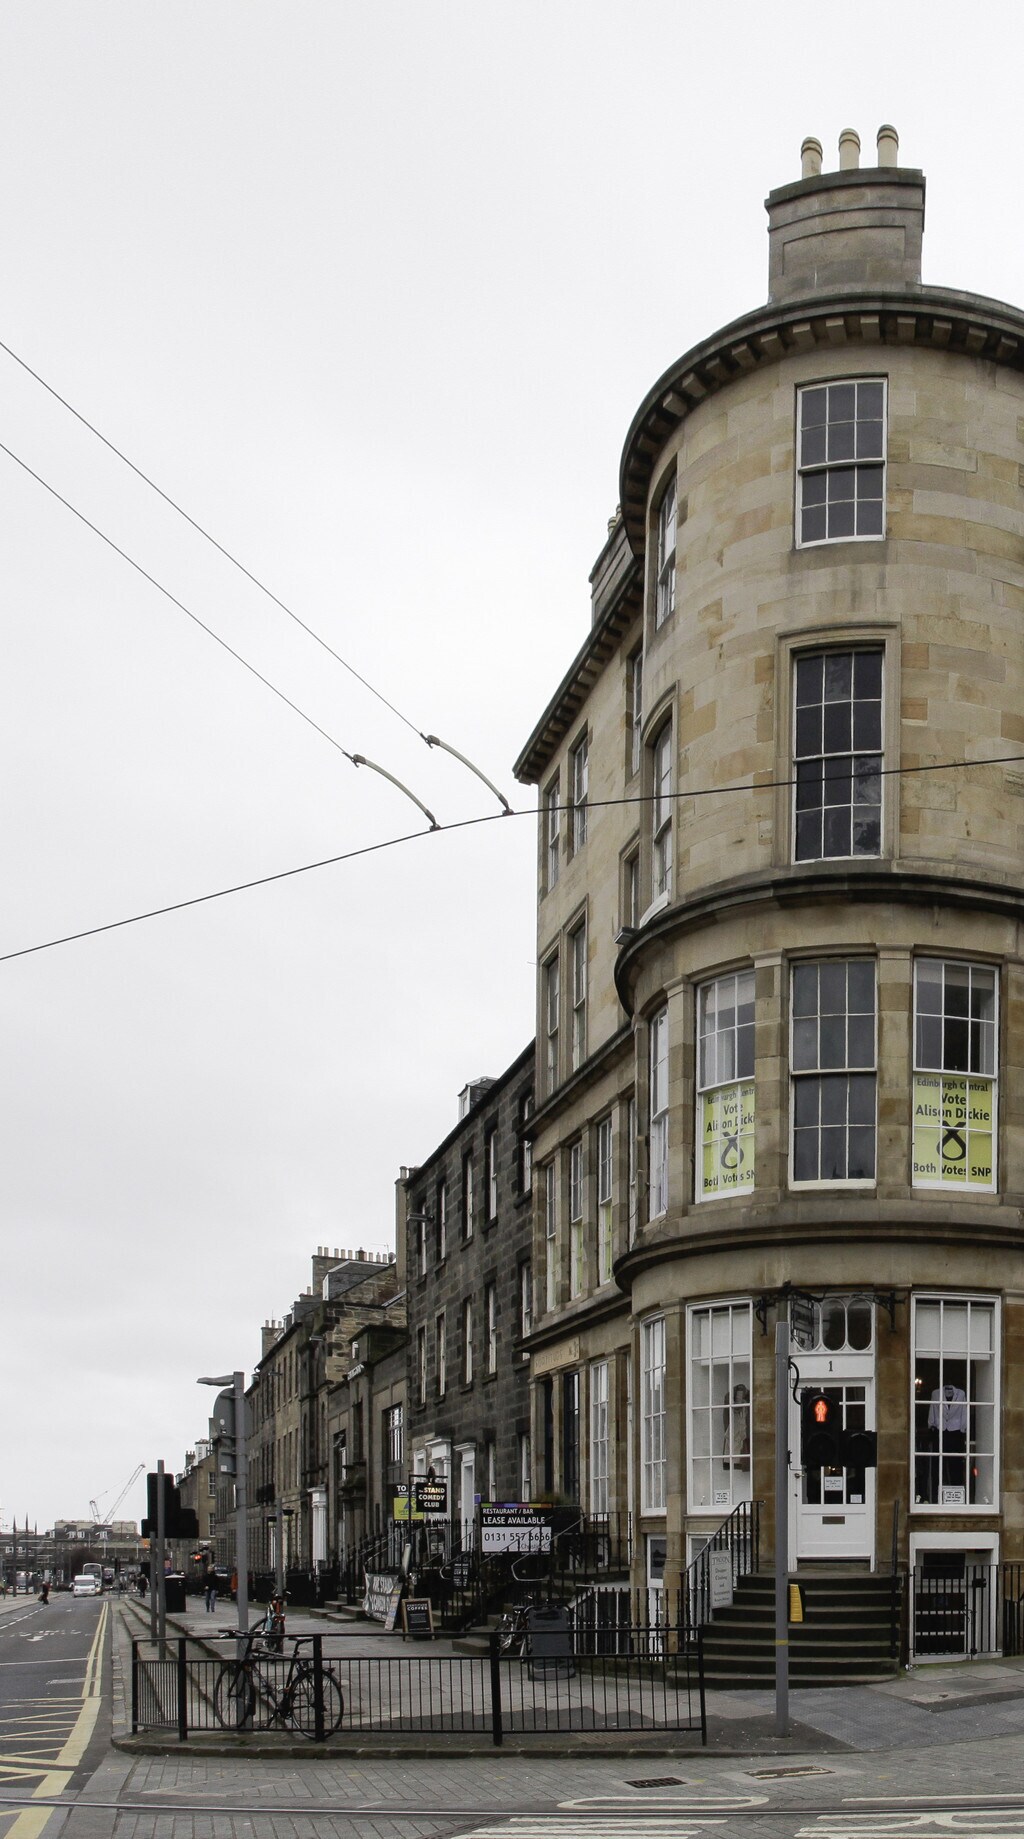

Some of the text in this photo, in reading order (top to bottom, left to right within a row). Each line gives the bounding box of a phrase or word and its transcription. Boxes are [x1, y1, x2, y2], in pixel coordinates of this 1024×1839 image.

[960, 1082, 988, 1092] Cntral
[956, 1108, 990, 1120] Dickie
[706, 1119, 732, 1132] Alion
[914, 1162, 936, 1173] Both
[972, 1167, 992, 1177] SNP
[484, 1533, 506, 1541] 0131
[510, 1533, 526, 1541] 557
